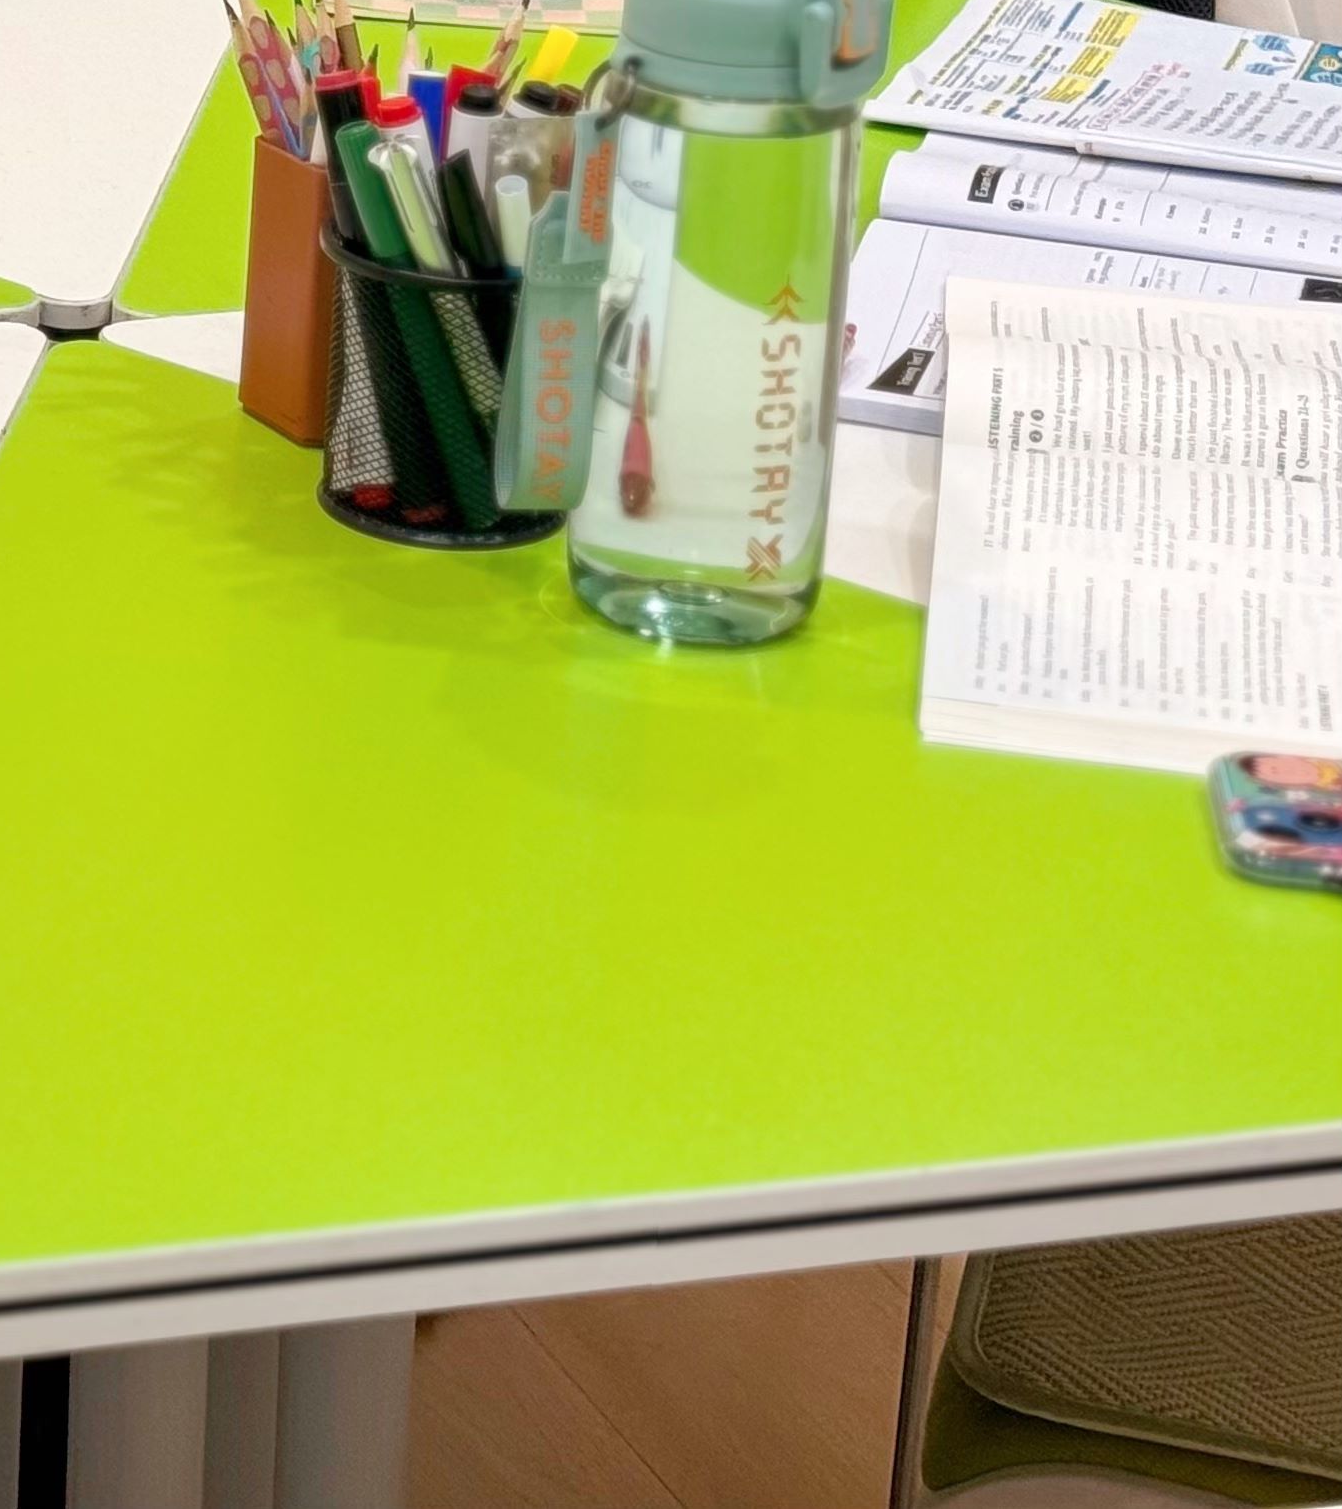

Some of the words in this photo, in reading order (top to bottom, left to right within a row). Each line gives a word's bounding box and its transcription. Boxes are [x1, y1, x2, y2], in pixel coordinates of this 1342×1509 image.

[992, 373, 1003, 394] PART
[536, 318, 577, 504] SHOTAY
[987, 396, 1002, 449] ISTENING
[1008, 410, 1025, 451] raining
[1054, 415, 1064, 432] had
[1152, 418, 1162, 443] about
[1173, 419, 1183, 435] and
[1222, 417, 1232, 431] The
[1052, 434, 1062, 448] We
[1103, 432, 1114, 449] just
[1118, 424, 1129, 455] picture
[1139, 424, 1149, 452] spend
[1208, 429, 1218, 446] just
[1152, 445, 1161, 458] do
[1187, 436, 1196, 461] much
[1207, 446, 1216, 463] I've
[1243, 440, 1252, 457] was
